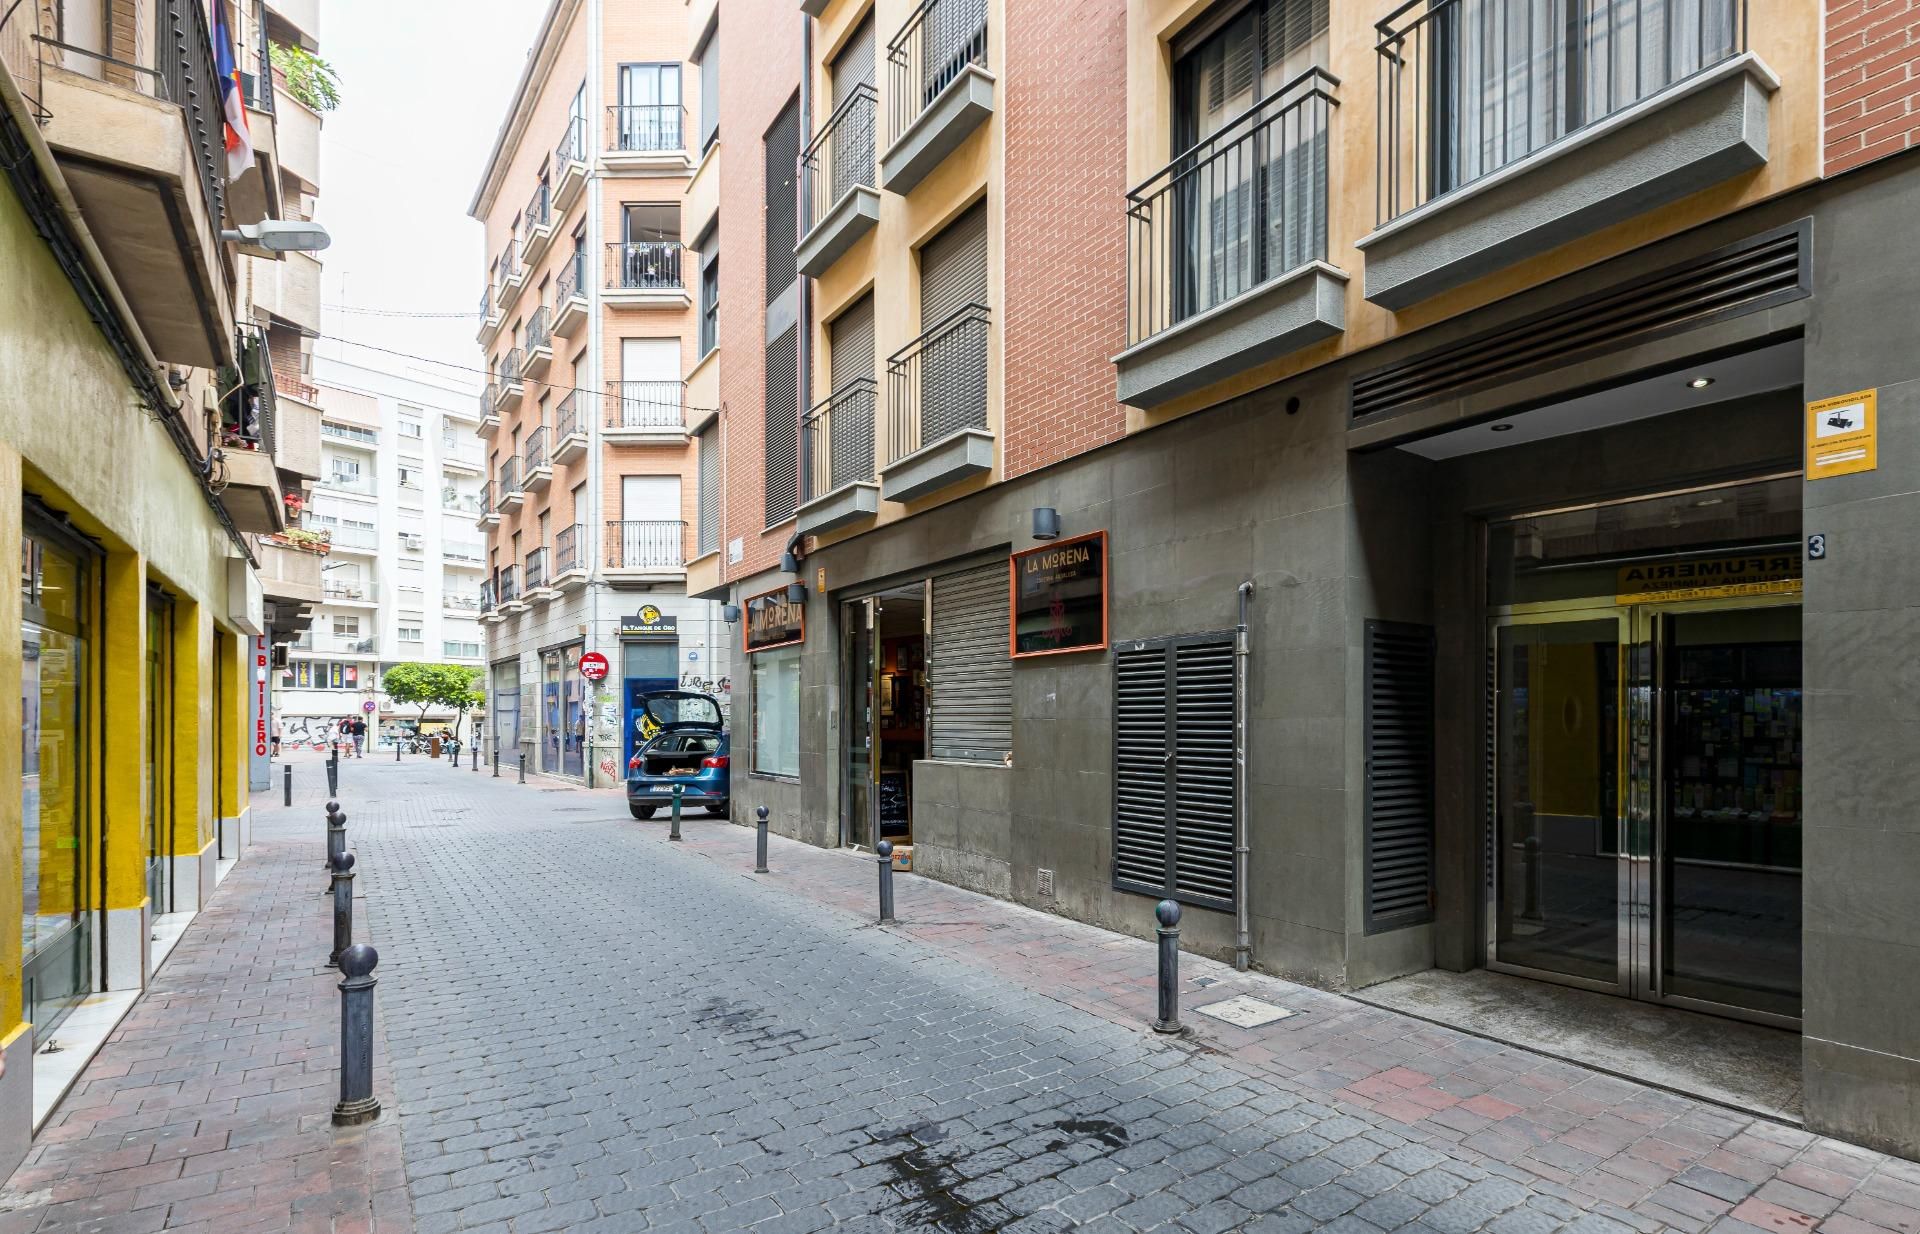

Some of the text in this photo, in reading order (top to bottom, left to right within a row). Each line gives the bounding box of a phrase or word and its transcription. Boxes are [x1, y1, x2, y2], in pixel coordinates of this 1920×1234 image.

[1809, 535, 1824, 557] 3
[1027, 546, 1090, 573] LA MORENA
